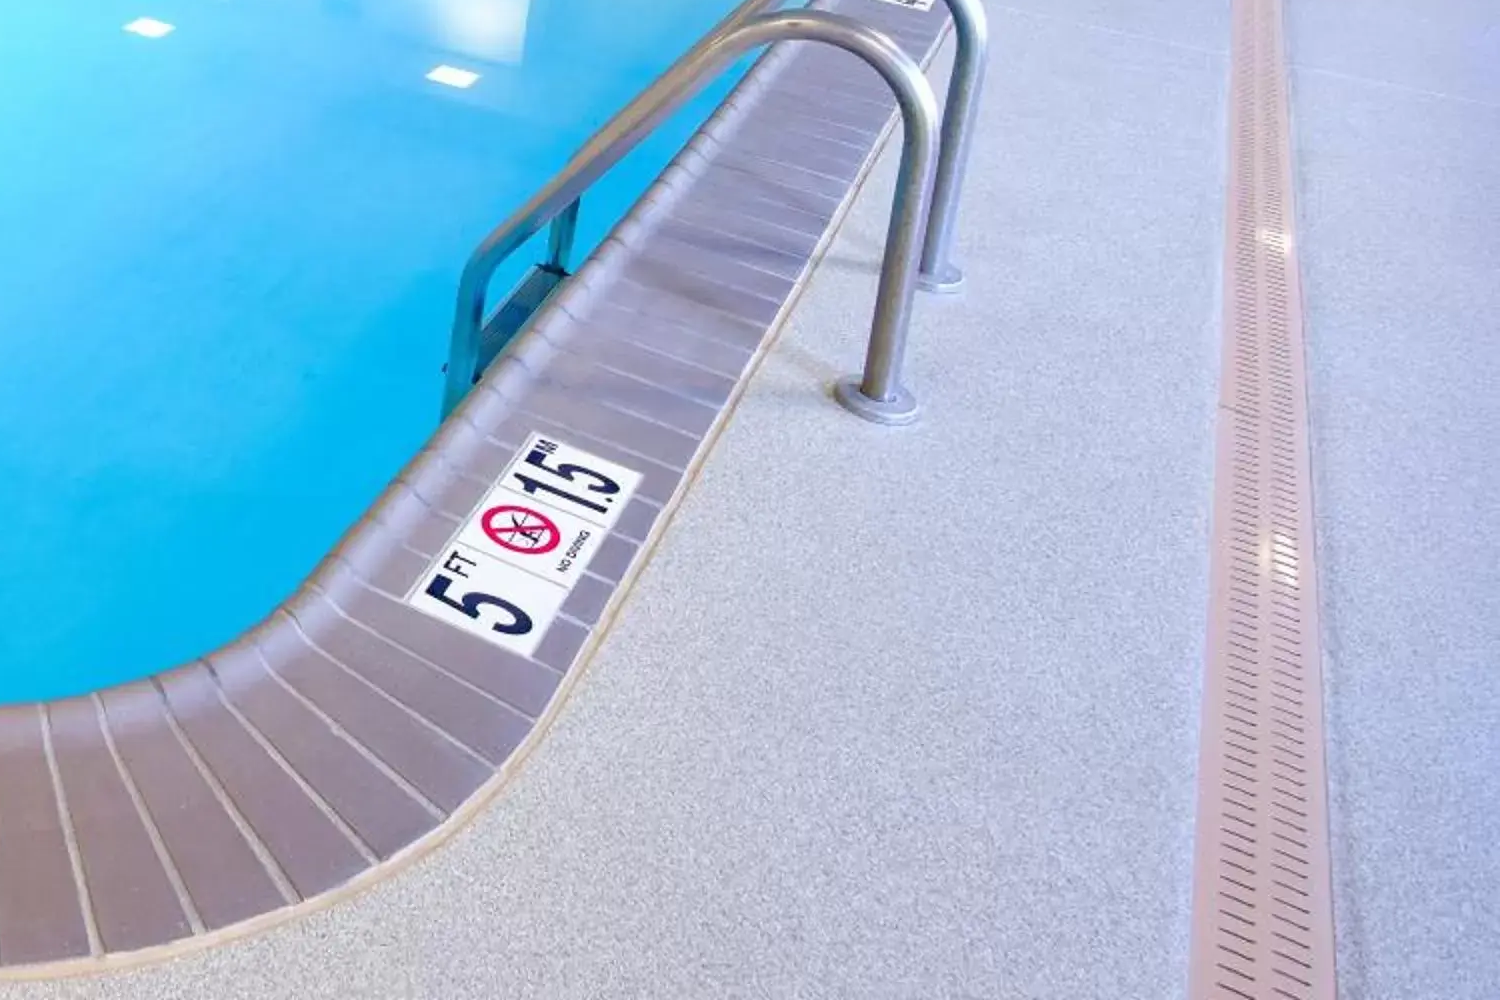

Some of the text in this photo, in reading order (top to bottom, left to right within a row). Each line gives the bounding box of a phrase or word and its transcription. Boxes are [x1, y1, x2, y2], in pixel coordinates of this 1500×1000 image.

[556, 529, 592, 573] NO DIVING
[425, 549, 533, 635] 5 FT
